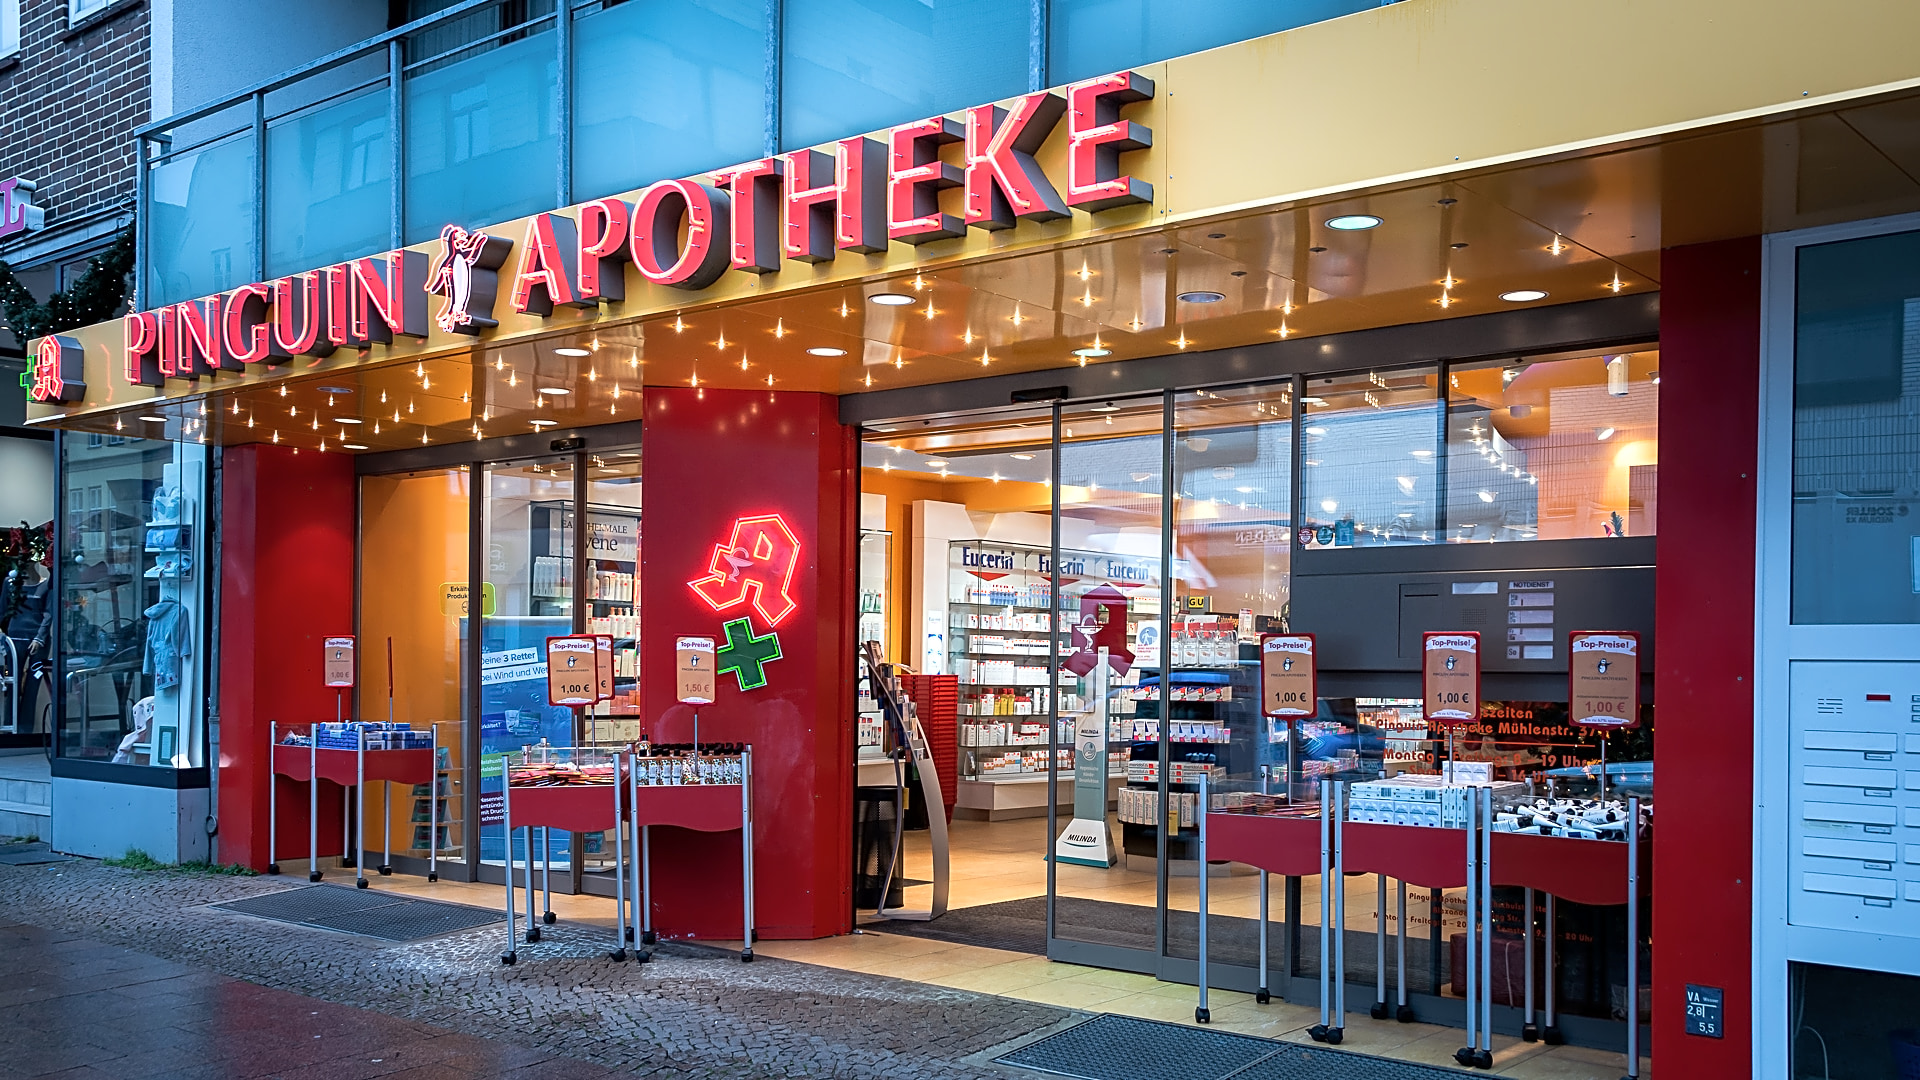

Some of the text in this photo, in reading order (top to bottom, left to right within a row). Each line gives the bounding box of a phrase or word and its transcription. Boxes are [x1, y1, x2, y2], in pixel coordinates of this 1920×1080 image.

[123, 70, 1133, 386] PINGUIN APOTHEKE
[587, 521, 628, 534] HERMALE
[586, 532, 618, 551] vène
[962, 546, 1013, 570] Eucerin
[1038, 553, 1084, 576] Euerin
[1106, 559, 1149, 580] Eucerin
[1268, 642, 1307, 650] Top-Preise!
[1431, 639, 1471, 647] Top-Preise!
[1580, 640, 1629, 649] Top-Preise!
[503, 654, 509, 663] 3
[511, 651, 536, 662] Retter
[331, 671, 344, 679] 1,00
[493, 669, 514, 680] Wind
[515, 667, 531, 677] und
[532, 666, 548, 675] Wet
[561, 683, 590, 694] 1,00 €
[600, 680, 607, 688] €
[685, 683, 710, 693] 1,50 €
[1275, 692, 1307, 704] 1,00 €
[1437, 692, 1469, 705] 1,00 €
[1585, 701, 1625, 714] 1,00 €
[1376, 718, 1424, 733] Pinguin
[1498, 721, 1574, 736] Mühlenstr.
[1383, 748, 1434, 764] Montag
[1452, 751, 1508, 768] Freitag:
[1513, 753, 1521, 765] 8
[1541, 754, 1557, 767] 19
[1562, 755, 1586, 768] Uhr
[1067, 833, 1097, 843] MILINDA
[1687, 990, 1700, 1002] VA
[1687, 1004, 1703, 1017] 2,8
[1699, 1021, 1715, 1034] 5,5
